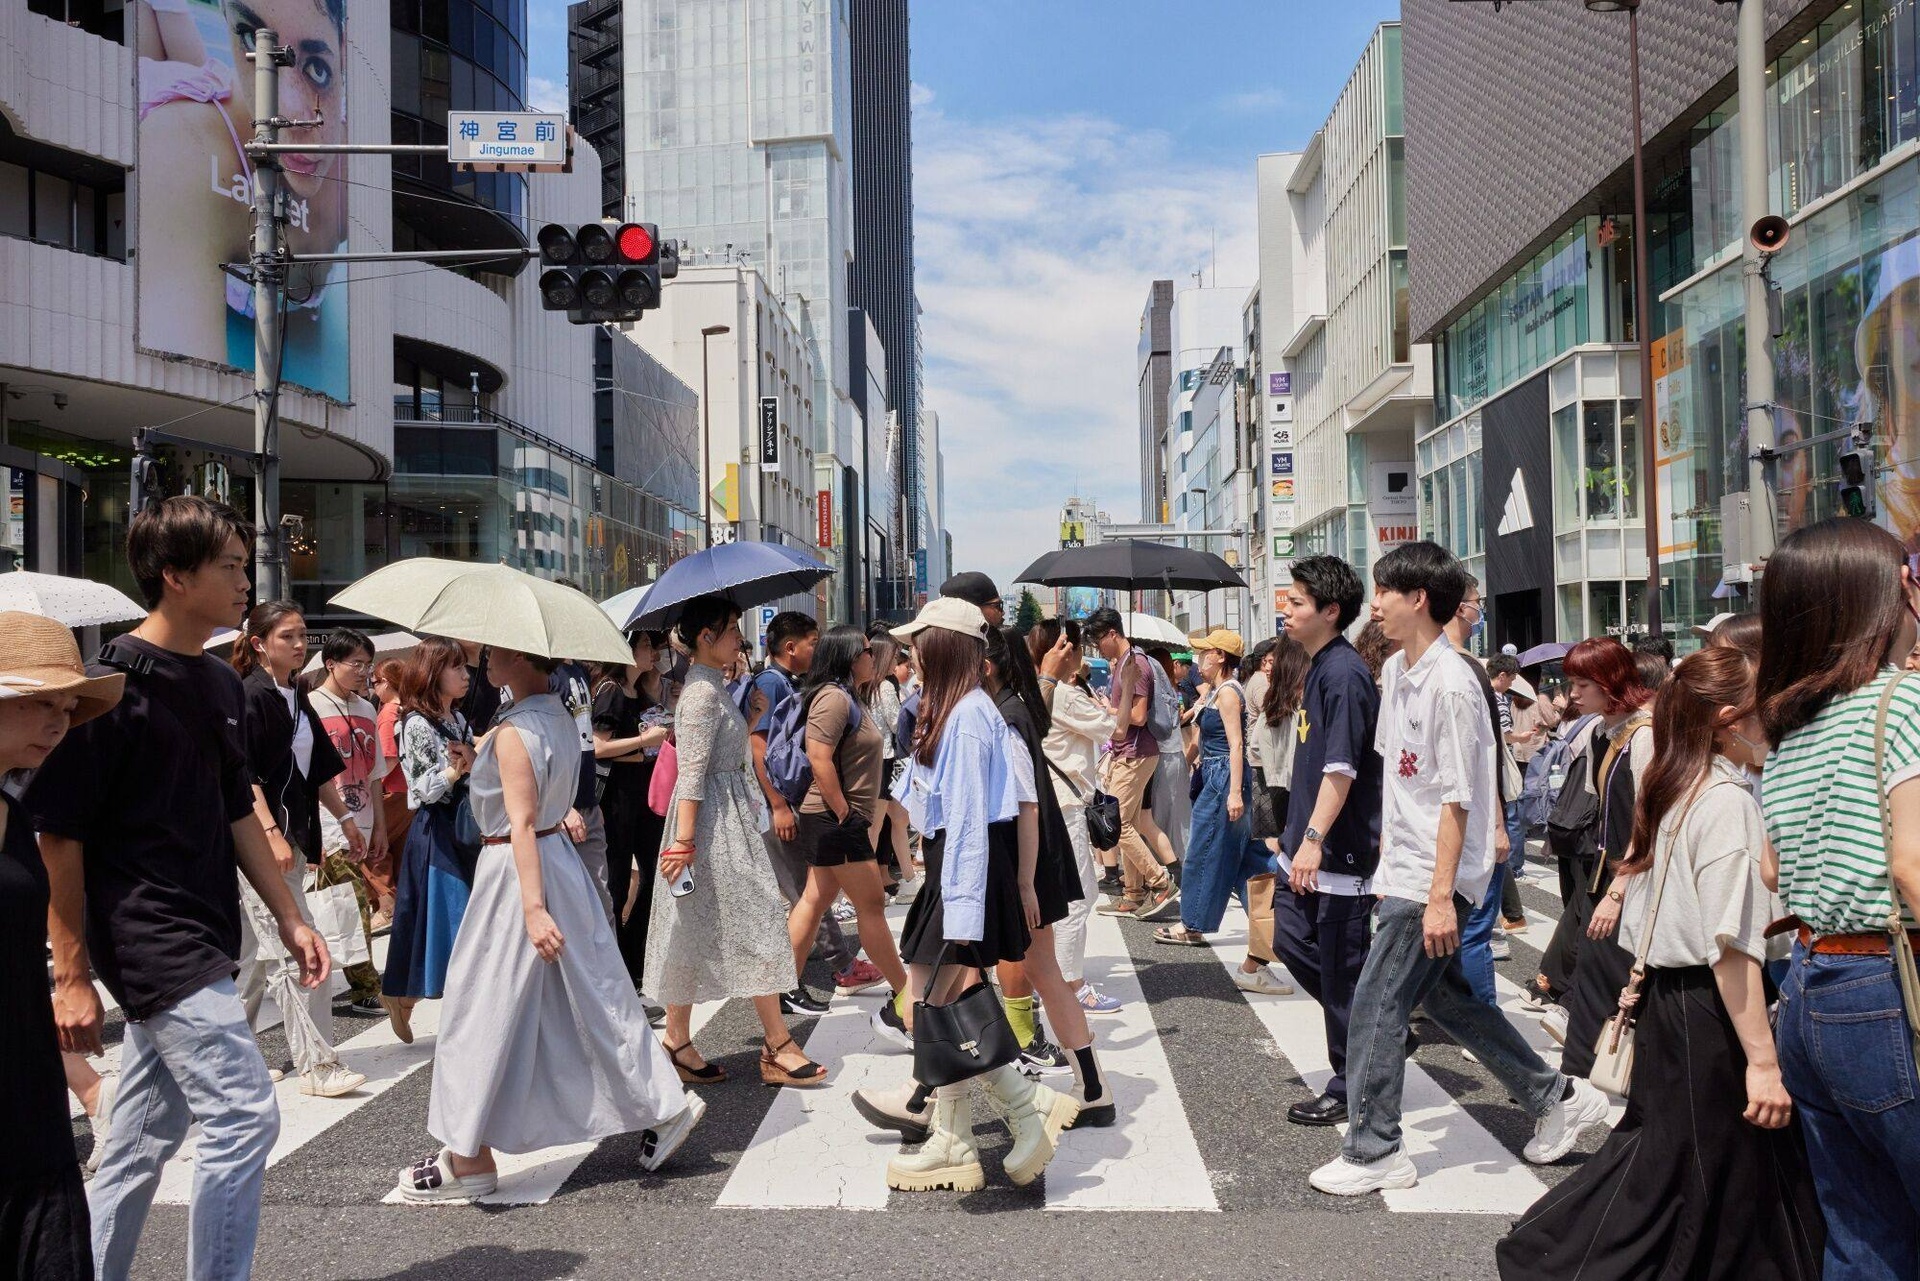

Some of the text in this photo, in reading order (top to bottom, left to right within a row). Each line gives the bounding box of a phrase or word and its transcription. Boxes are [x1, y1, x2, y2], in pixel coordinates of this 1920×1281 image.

[1781, 63, 1815, 104] JILL
[1820, 61, 1832, 74] by
[459, 120, 556, 142] 神宮前
[479, 144, 535, 157] Jingumae
[763, 609, 774, 624] P
